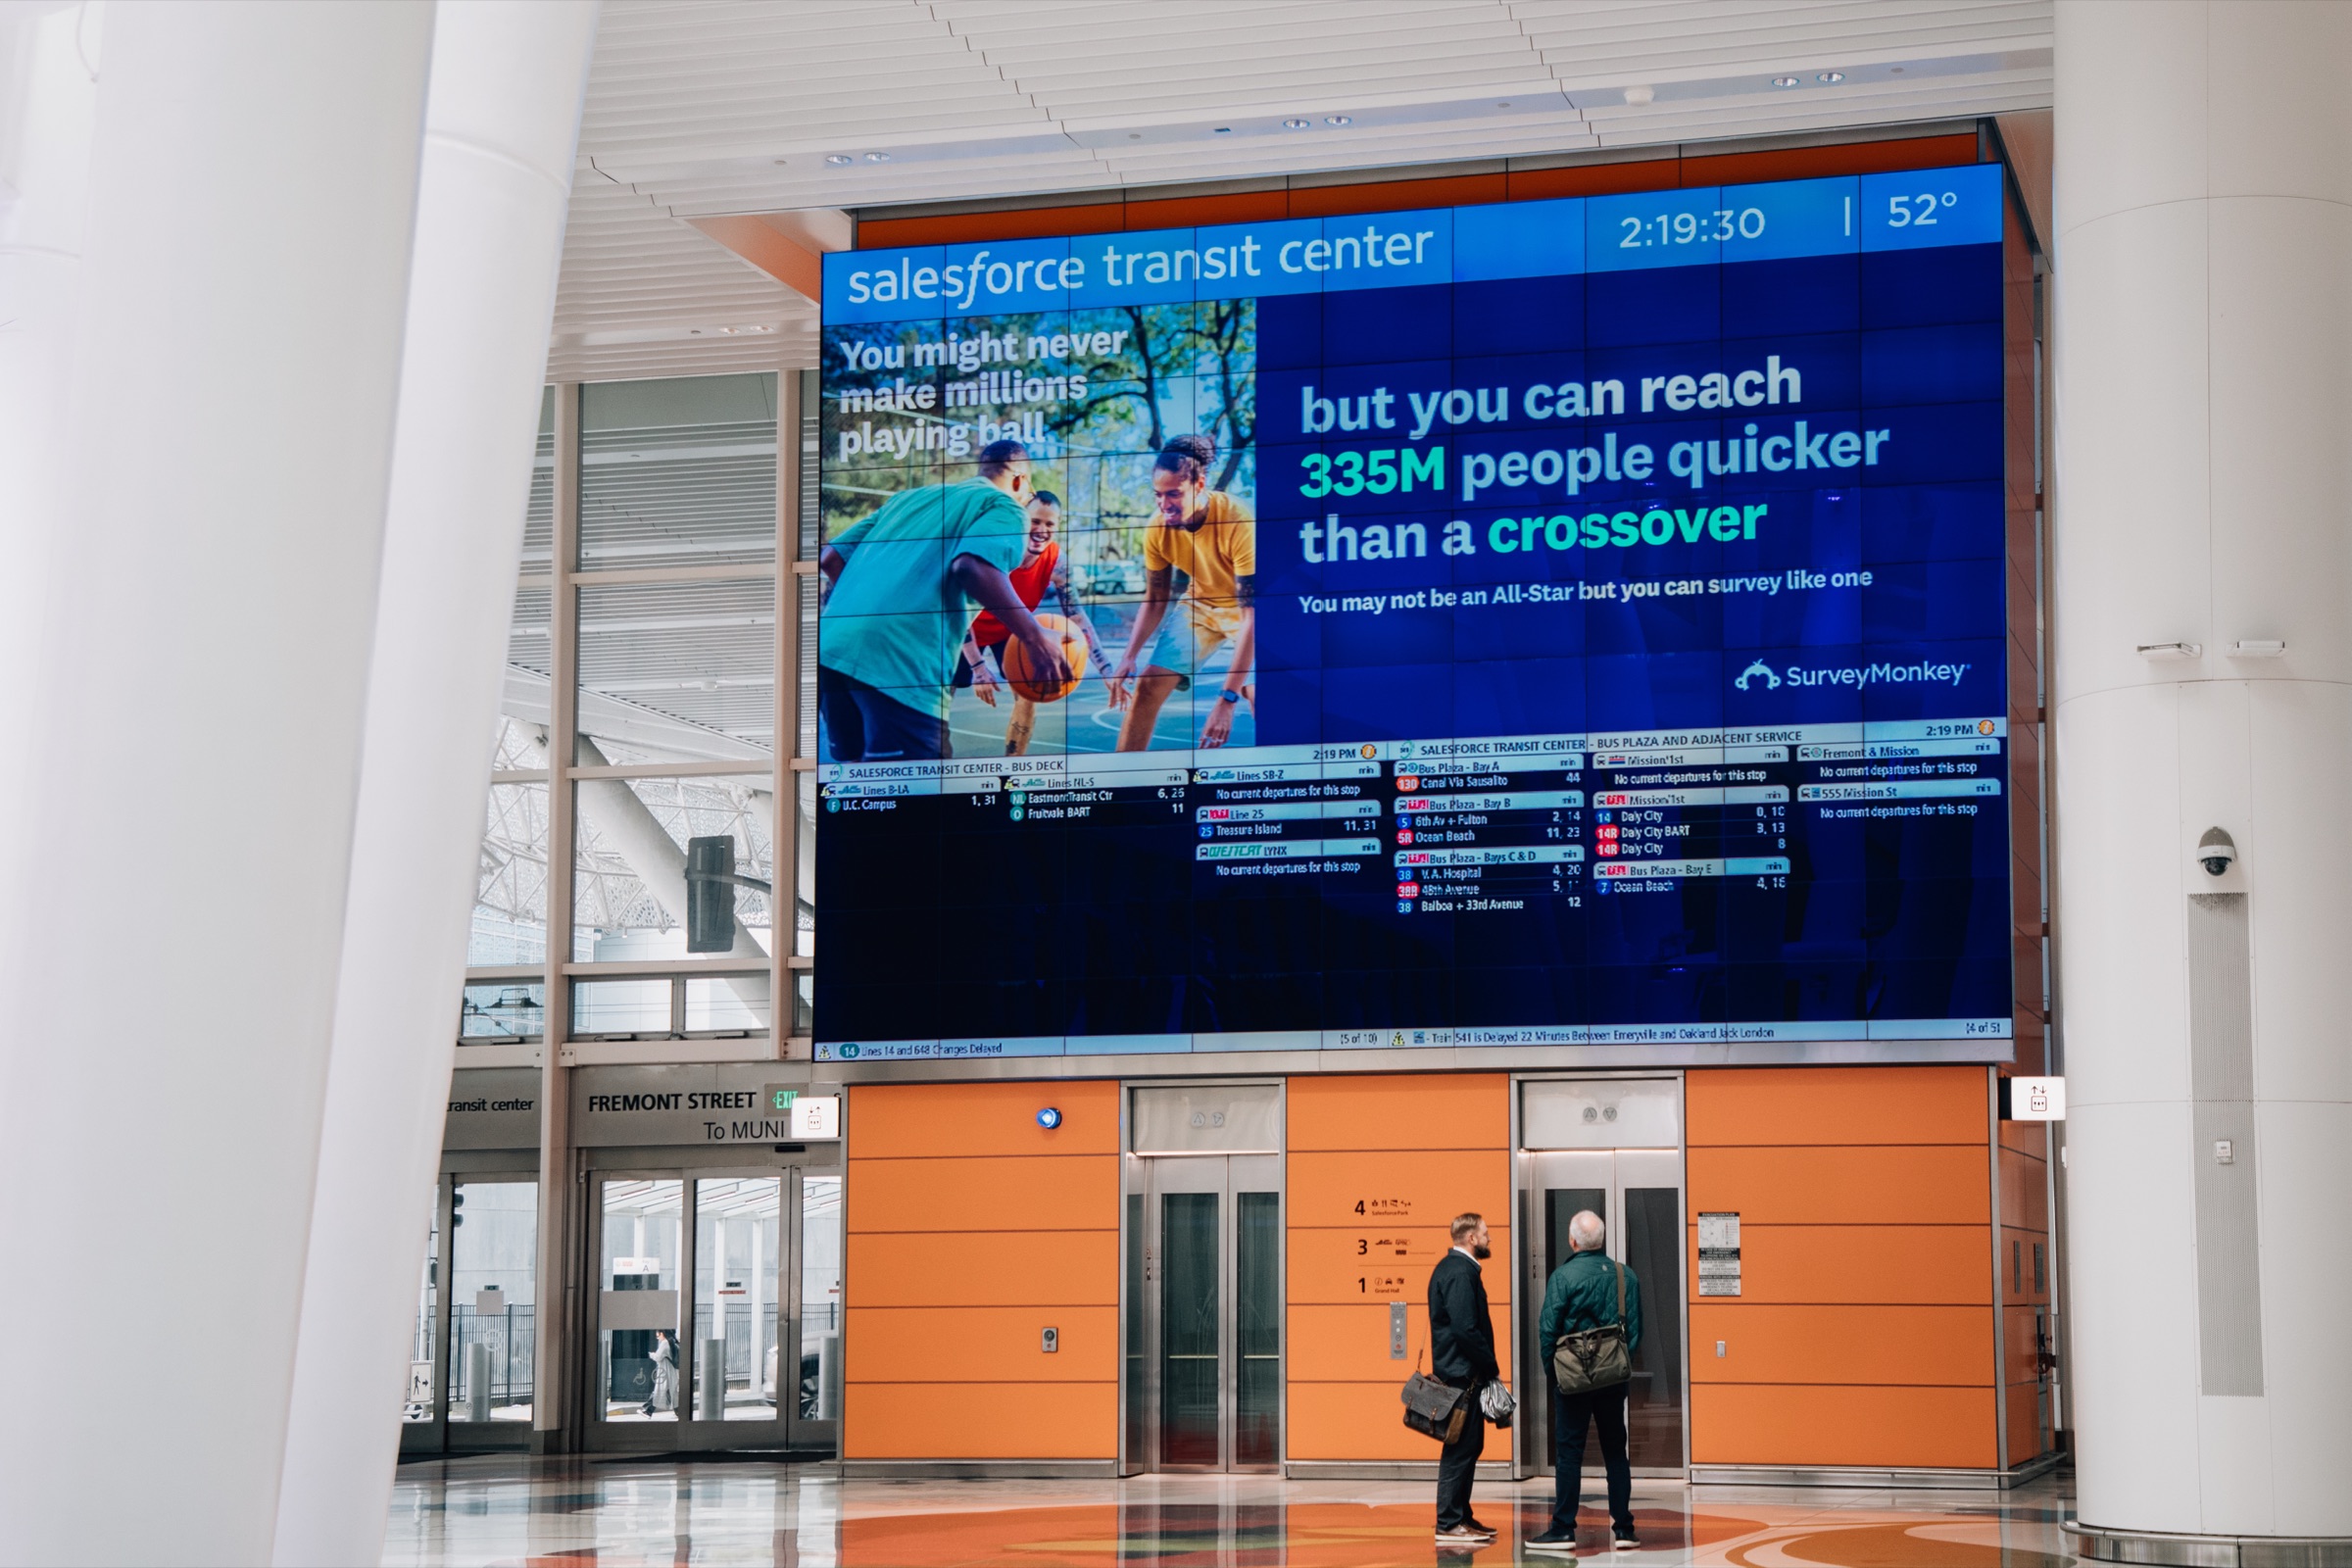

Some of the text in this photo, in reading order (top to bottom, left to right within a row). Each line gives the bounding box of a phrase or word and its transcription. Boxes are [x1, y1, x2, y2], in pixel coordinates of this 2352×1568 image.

[1887, 192, 1957, 228] 52°
[1619, 208, 1765, 248] 2:19:30
[848, 225, 1435, 310] salesforce transit center
[840, 327, 1128, 372] You might never
[839, 369, 1088, 414] make millions
[1300, 355, 1801, 440] but you can reach
[838, 411, 1046, 462] playing ball
[1298, 421, 1889, 502] 335M people quicker
[1298, 502, 1768, 564] than a crossover
[1298, 567, 1873, 614] You may not be an All-Star but you can survey like one
[1787, 661, 1967, 688] SurveyMonkey
[1927, 724, 1973, 736] 2:19 PM
[1421, 743, 1490, 755] SALESFORCE
[1494, 742, 1540, 752] TRANSIT
[1543, 740, 1586, 750] CENTER
[1597, 738, 1619, 749] BUS
[1623, 737, 1659, 748] PLAZA
[1662, 735, 1688, 746] AND
[1691, 734, 1752, 745] ADJACENT
[1756, 731, 1801, 742] SERVICE
[1313, 749, 1355, 760] 2:19 PM
[1824, 746, 1920, 759] Fremont & Mission
[849, 766, 913, 778] SALESFORCE
[915, 765, 959, 775] TRANSIT
[963, 763, 1003, 773] CENTER
[1011, 762, 1032, 772] BUS
[1037, 760, 1063, 770] DECK
[1418, 761, 1499, 773] Bus Plaza Bay A
[1820, 761, 1954, 777] No for this
[1237, 771, 1260, 780] Lines
[1398, 772, 1581, 789] 130 44
[863, 786, 886, 795] Lines
[1048, 779, 1071, 788] Lines
[1099, 791, 1113, 801] Ctr
[1217, 789, 1229, 800] No
[1308, 786, 1320, 796] for
[1324, 784, 1339, 795] this
[1341, 785, 1360, 796] stop
[1822, 786, 1897, 798] 555 Mission St
[861, 800, 897, 811] Campus
[984, 795, 996, 806] 31
[1067, 804, 1184, 816] BART 11
[1449, 799, 1475, 808] Plaza
[1485, 799, 1500, 809] Bay
[1504, 799, 1510, 808] B
[1230, 810, 1249, 819] Line
[1252, 809, 1264, 818] 25
[1415, 816, 1431, 826] 6th
[1458, 815, 1488, 825] Fulton
[1598, 812, 1610, 822] 14
[1643, 810, 1663, 822] City
[1200, 820, 1376, 837] 25 Treasure Island 31
[1446, 827, 1580, 841] Beach 23
[1643, 822, 1785, 839] City BART 13
[1643, 839, 1786, 855] City 8
[1430, 855, 1446, 863] Bus
[1449, 853, 1475, 862] Plaza
[1485, 852, 1506, 863] Bays
[1508, 852, 1515, 860] C
[1517, 852, 1526, 860] &
[1529, 852, 1536, 860] D
[1216, 865, 1229, 875] No
[1309, 862, 1321, 872] for
[1324, 860, 1339, 871] this
[1341, 862, 1360, 873] stop
[1399, 870, 1411, 879] 38
[1631, 866, 1647, 875] Bus
[1650, 865, 1676, 875] Plaza
[1686, 864, 1704, 876] Bay
[1706, 863, 1712, 873] E
[1398, 897, 1582, 912] 38 33rd 12
[1455, 1033, 1471, 1043] 541
[1474, 1032, 1482, 1042] is
[1521, 1032, 1532, 1042] 22
[845, 1047, 855, 1055] 14
[885, 1047, 894, 1055] 14
[897, 1046, 912, 1054] and
[446, 1098, 534, 1111] ransit center
[589, 1092, 757, 1111] FREMONT STREET
[704, 1121, 784, 1140] To MUNI
[1354, 1200, 1365, 1215] 4
[1357, 1239, 1367, 1254] 3
[1358, 1278, 1365, 1293] 1
